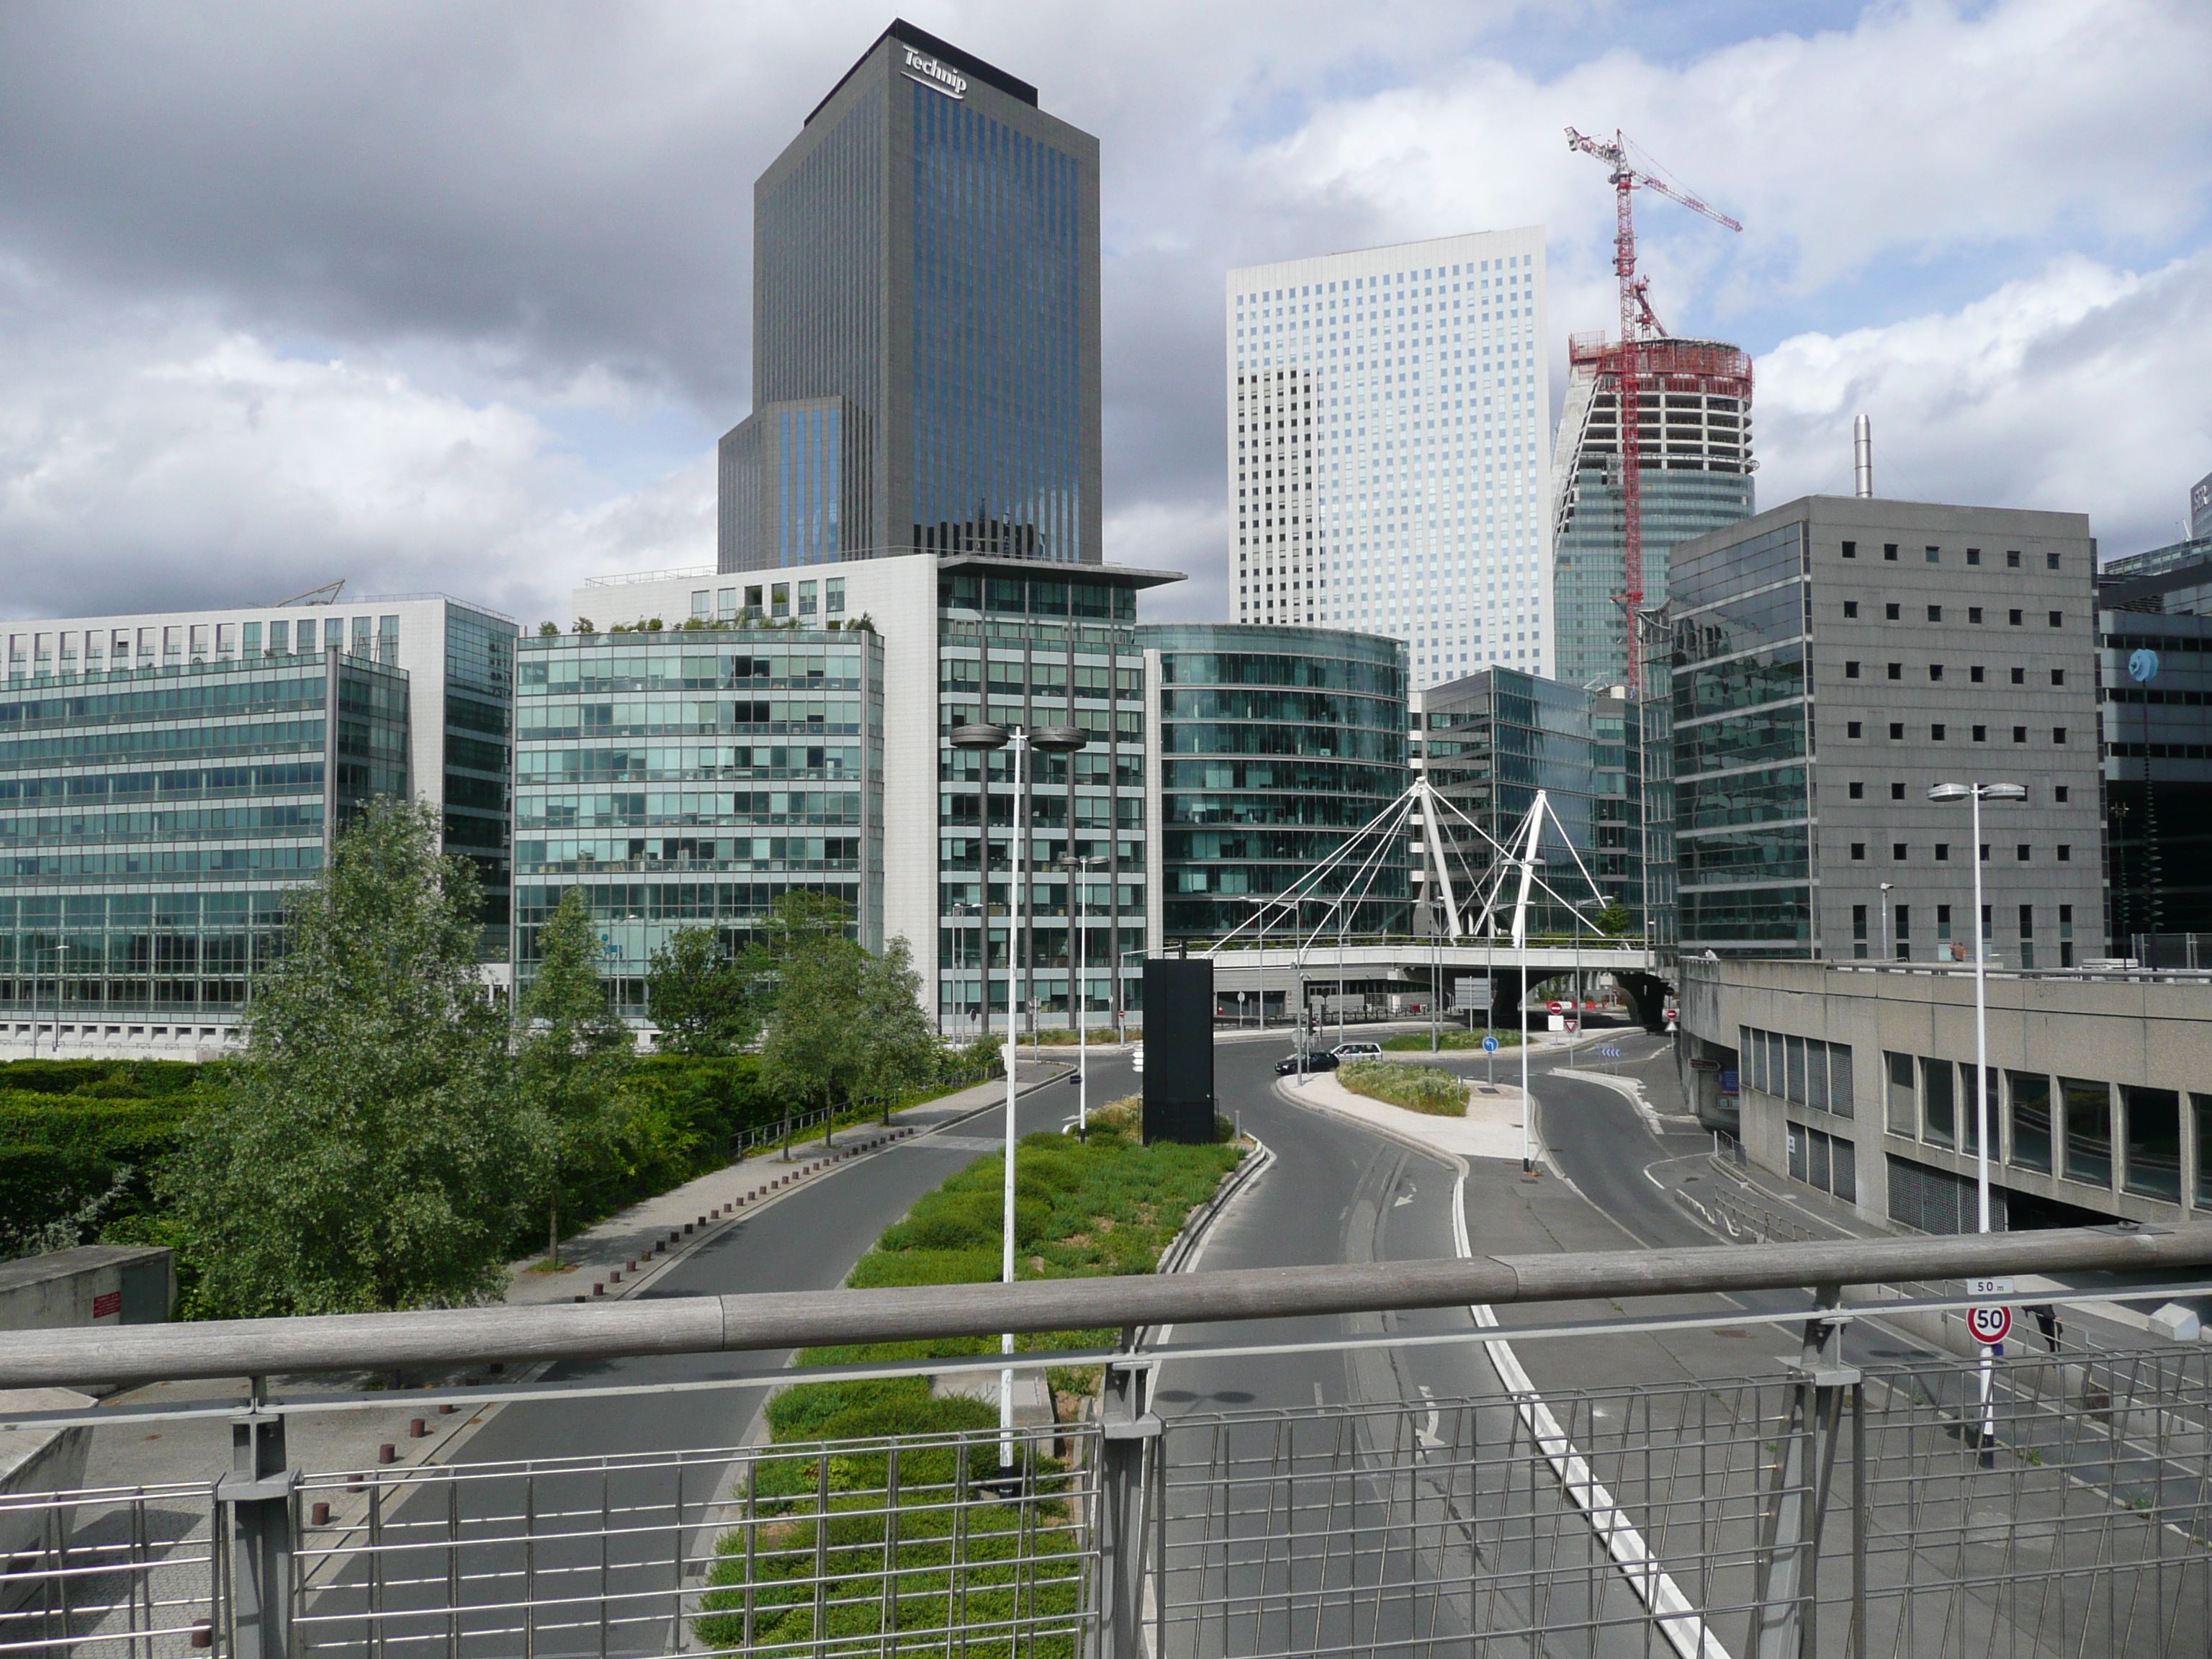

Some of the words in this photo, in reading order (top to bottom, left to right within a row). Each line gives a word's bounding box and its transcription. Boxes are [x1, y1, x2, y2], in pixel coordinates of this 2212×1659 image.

[903, 45, 966, 94] Technip
[1977, 1282, 1993, 1292] 50
[1977, 1310, 2003, 1328] 50
